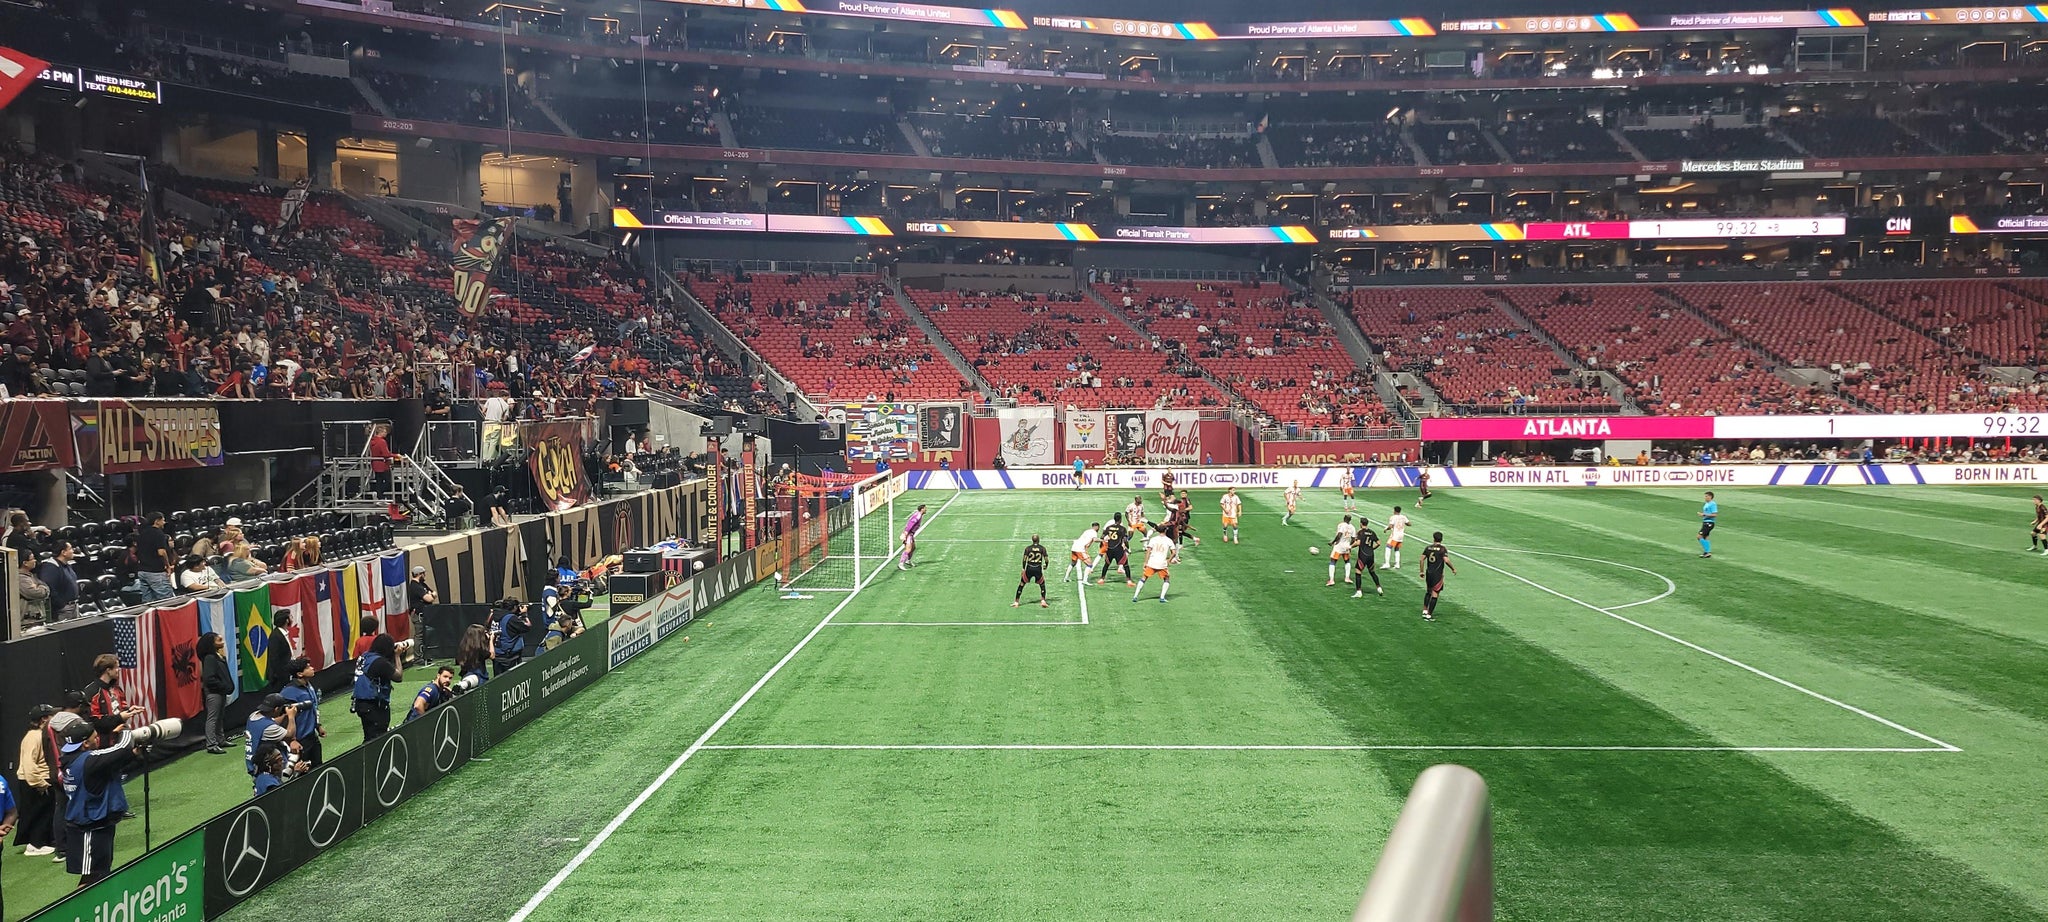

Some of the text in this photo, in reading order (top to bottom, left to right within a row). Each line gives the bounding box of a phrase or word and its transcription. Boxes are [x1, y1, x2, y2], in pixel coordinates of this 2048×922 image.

[839, 2, 950, 18] Proud Partner of Atlanta United
[1869, 12, 1921, 21] RIDE marta
[1033, 17, 1082, 29] RIDE marta
[1441, 21, 1492, 31] RIDE marta
[1670, 15, 1784, 26] Proud Partner of Atlanta United
[1248, 24, 1357, 34] Proud Partner of Atlanta United
[53, 71, 74, 84] PM
[95, 74, 146, 89] NEED HELP?
[85, 81, 157, 99] TEXT 470-444-0234
[383, 121, 413, 131] 202-203
[723, 150, 749, 159] 204-205
[1681, 160, 1758, 172] Mercedes-Benz
[1759, 159, 1804, 171] Stadium
[436, 206, 448, 214] 104
[664, 214, 753, 226] Official Transit Partner
[1886, 217, 1911, 232] CIN
[1997, 218, 2048, 228] Official Trans
[1116, 228, 1191, 239] Official Transit Partner
[1563, 223, 1591, 237] ATL
[1656, 223, 1661, 236] 1
[1716, 221, 1757, 235] 99:32
[1811, 221, 1819, 234] 3
[1523, 418, 1611, 436] ATLANTA
[1827, 418, 1834, 435] 1
[1983, 416, 2040, 434] 99:32
[103, 406, 223, 465] ALL STRIPES
[18, 448, 53, 461] FACTION
[1096, 472, 1120, 485] ATL
[1162, 472, 1207, 485] NITED
[1241, 471, 1279, 485] DRIVE
[1490, 470, 1570, 483] BORN IN ATL
[1613, 470, 1660, 483] UNITED
[1696, 469, 1735, 482] DRIVE
[1955, 468, 2039, 481] BORN IN ATL
[707, 464, 717, 542] UNITE & CONQUER
[1365, 536, 1372, 547] 4
[1028, 552, 1042, 563] 22
[1428, 552, 1436, 563] 6
[614, 595, 642, 603] CONQUER
[657, 606, 677, 626] AMERICAN
[659, 611, 689, 636] INSURANCE
[611, 627, 636, 653] AMERICAN
[613, 635, 649, 664] INSURANCE
[501, 678, 531, 712] EMORY
[501, 700, 530, 723] HEALTHCARE
